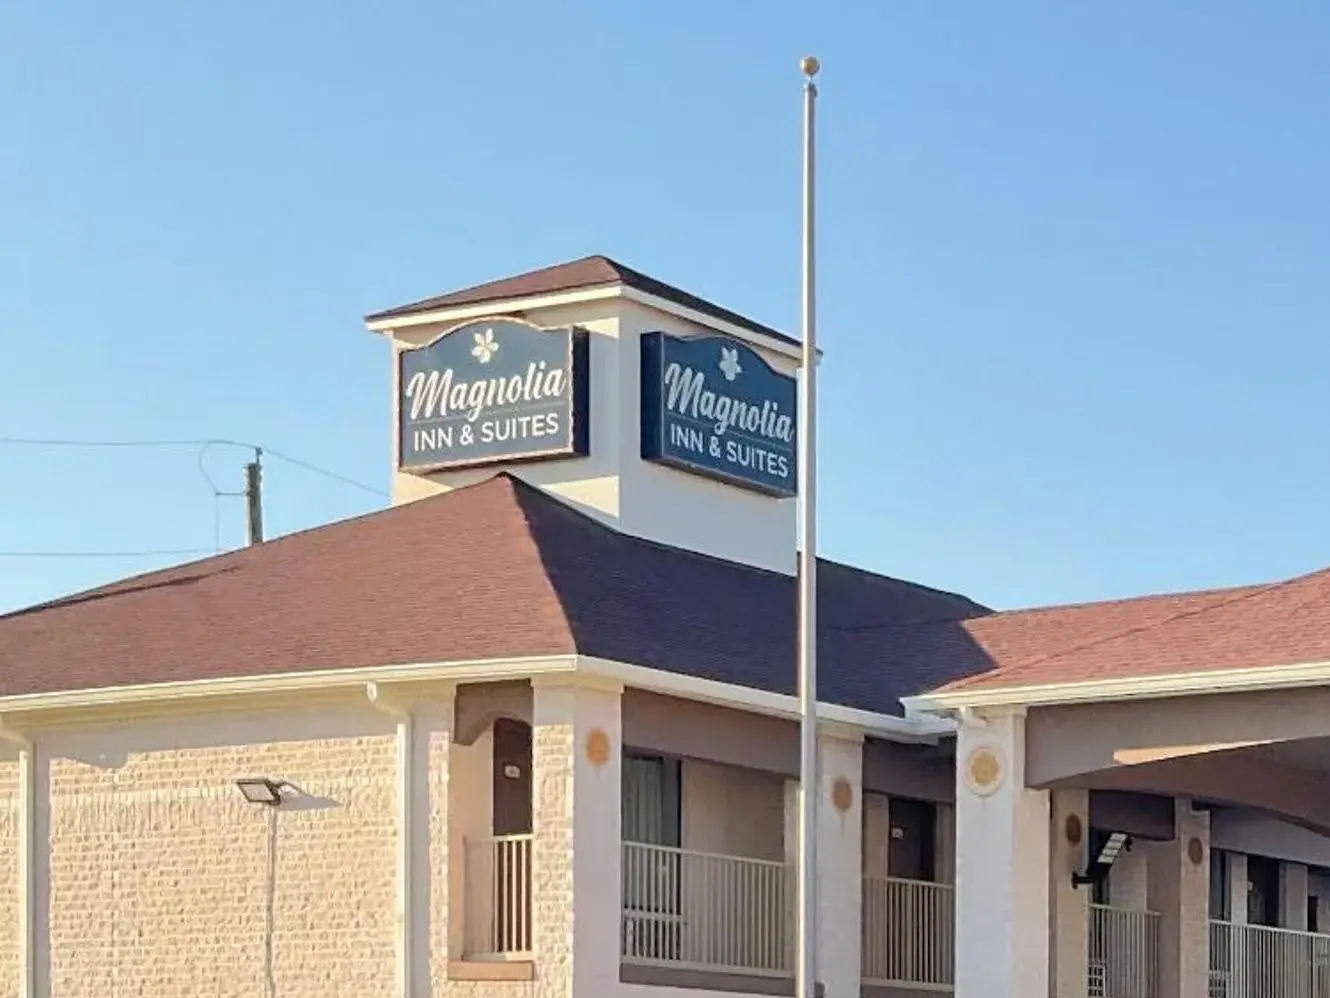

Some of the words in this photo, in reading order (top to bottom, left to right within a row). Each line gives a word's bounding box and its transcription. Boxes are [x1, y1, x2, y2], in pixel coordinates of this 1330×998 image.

[405, 360, 567, 422] Magnolia
[665, 363, 794, 442] Magnolia
[414, 427, 453, 451] INN
[460, 424, 474, 445] &
[481, 413, 559, 443] SUITES
[670, 423, 703, 454] INN
[709, 436, 721, 458] &
[726, 441, 788, 478] SUITES
